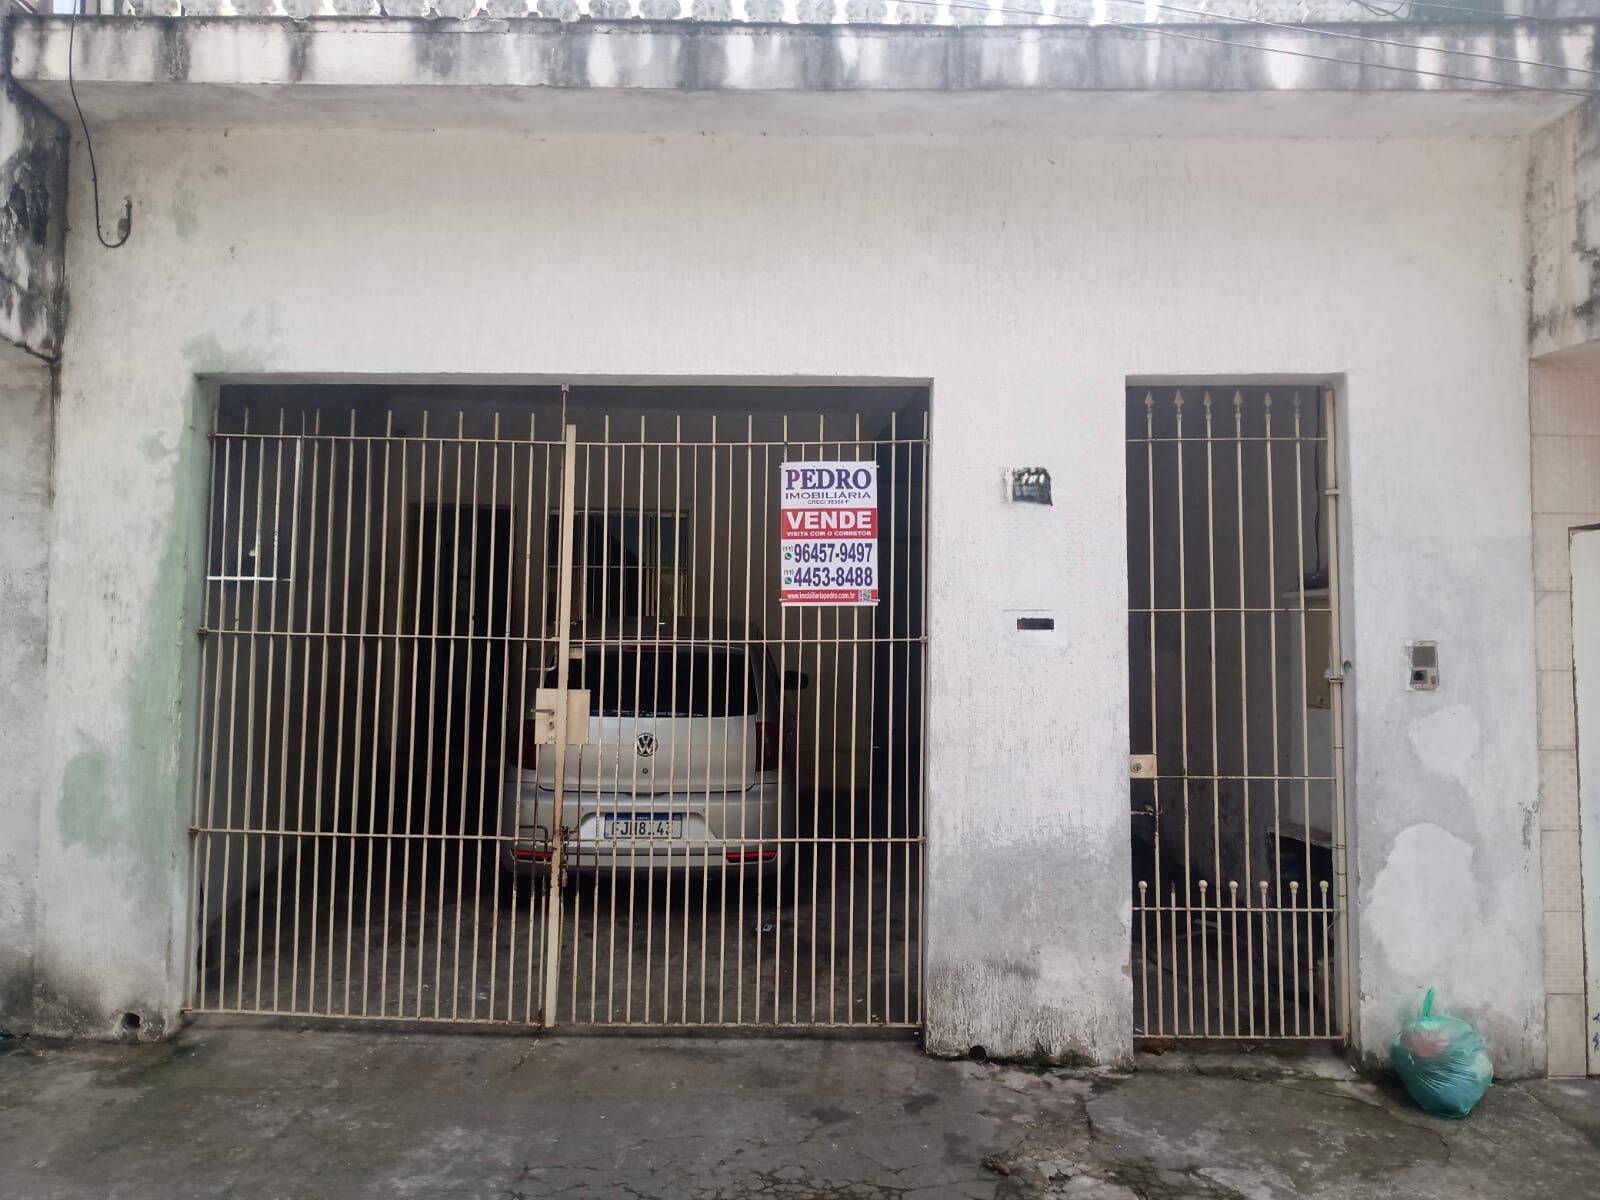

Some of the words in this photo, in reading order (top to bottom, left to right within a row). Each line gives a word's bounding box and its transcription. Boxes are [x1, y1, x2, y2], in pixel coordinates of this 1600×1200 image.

[785, 468, 872, 490] PEDRO
[786, 511, 872, 529] VENDE
[794, 543, 872, 562] 96457-9497
[794, 567, 873, 586] 4453-8488
